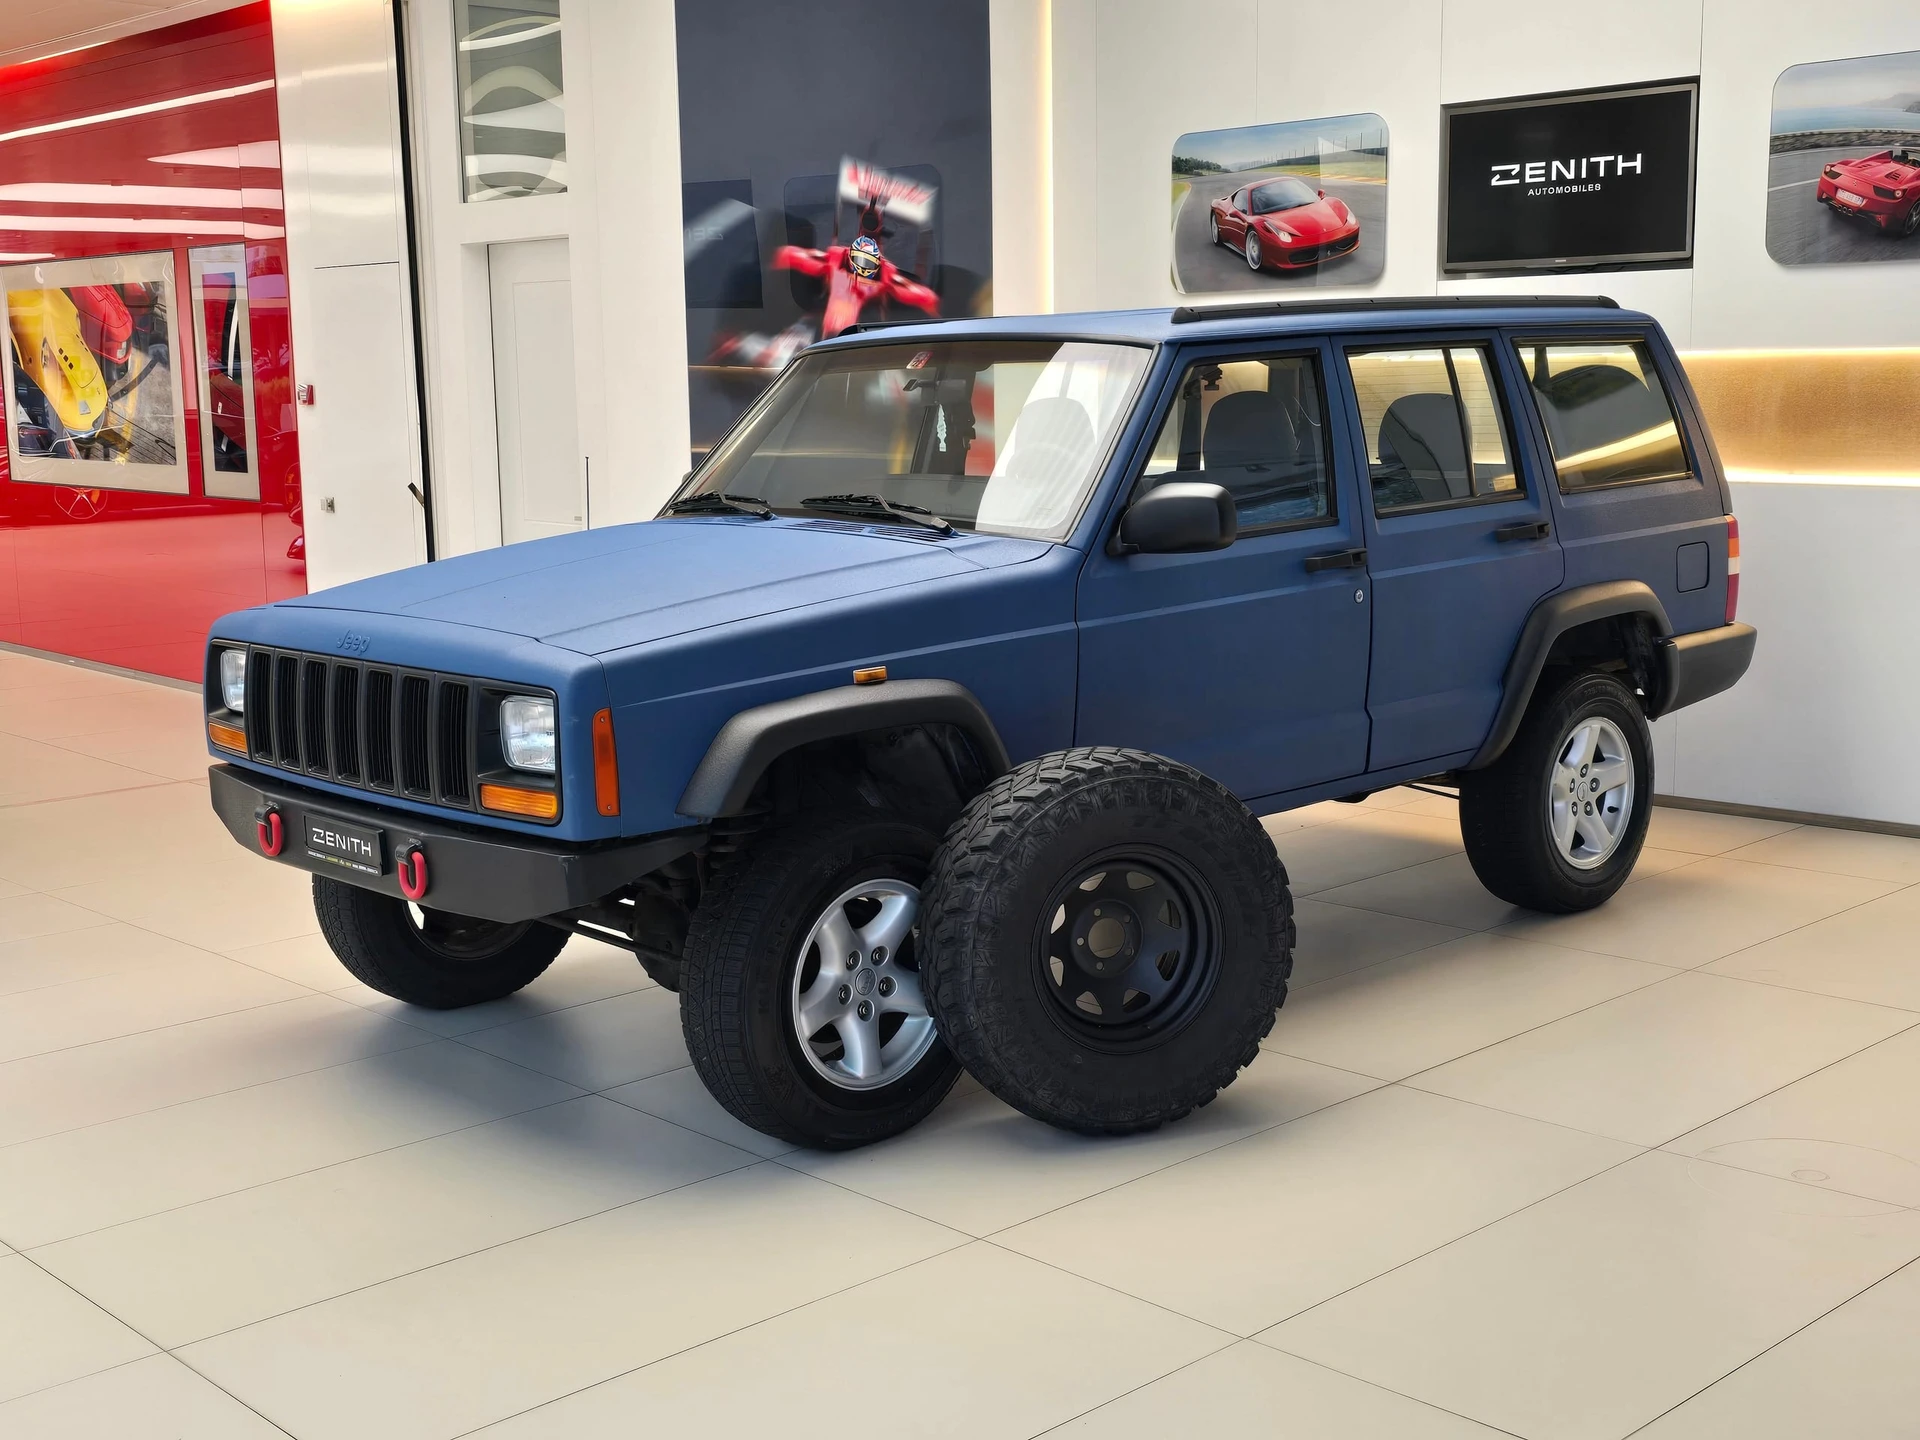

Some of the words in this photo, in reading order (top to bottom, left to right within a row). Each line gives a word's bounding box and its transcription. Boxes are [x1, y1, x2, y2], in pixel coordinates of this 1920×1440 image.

[1490, 152, 1642, 187] ZENITH
[1526, 183, 1602, 197] AUTOMOBILES
[336, 629, 371, 656] Jeep
[312, 827, 372, 857] ZENITH
